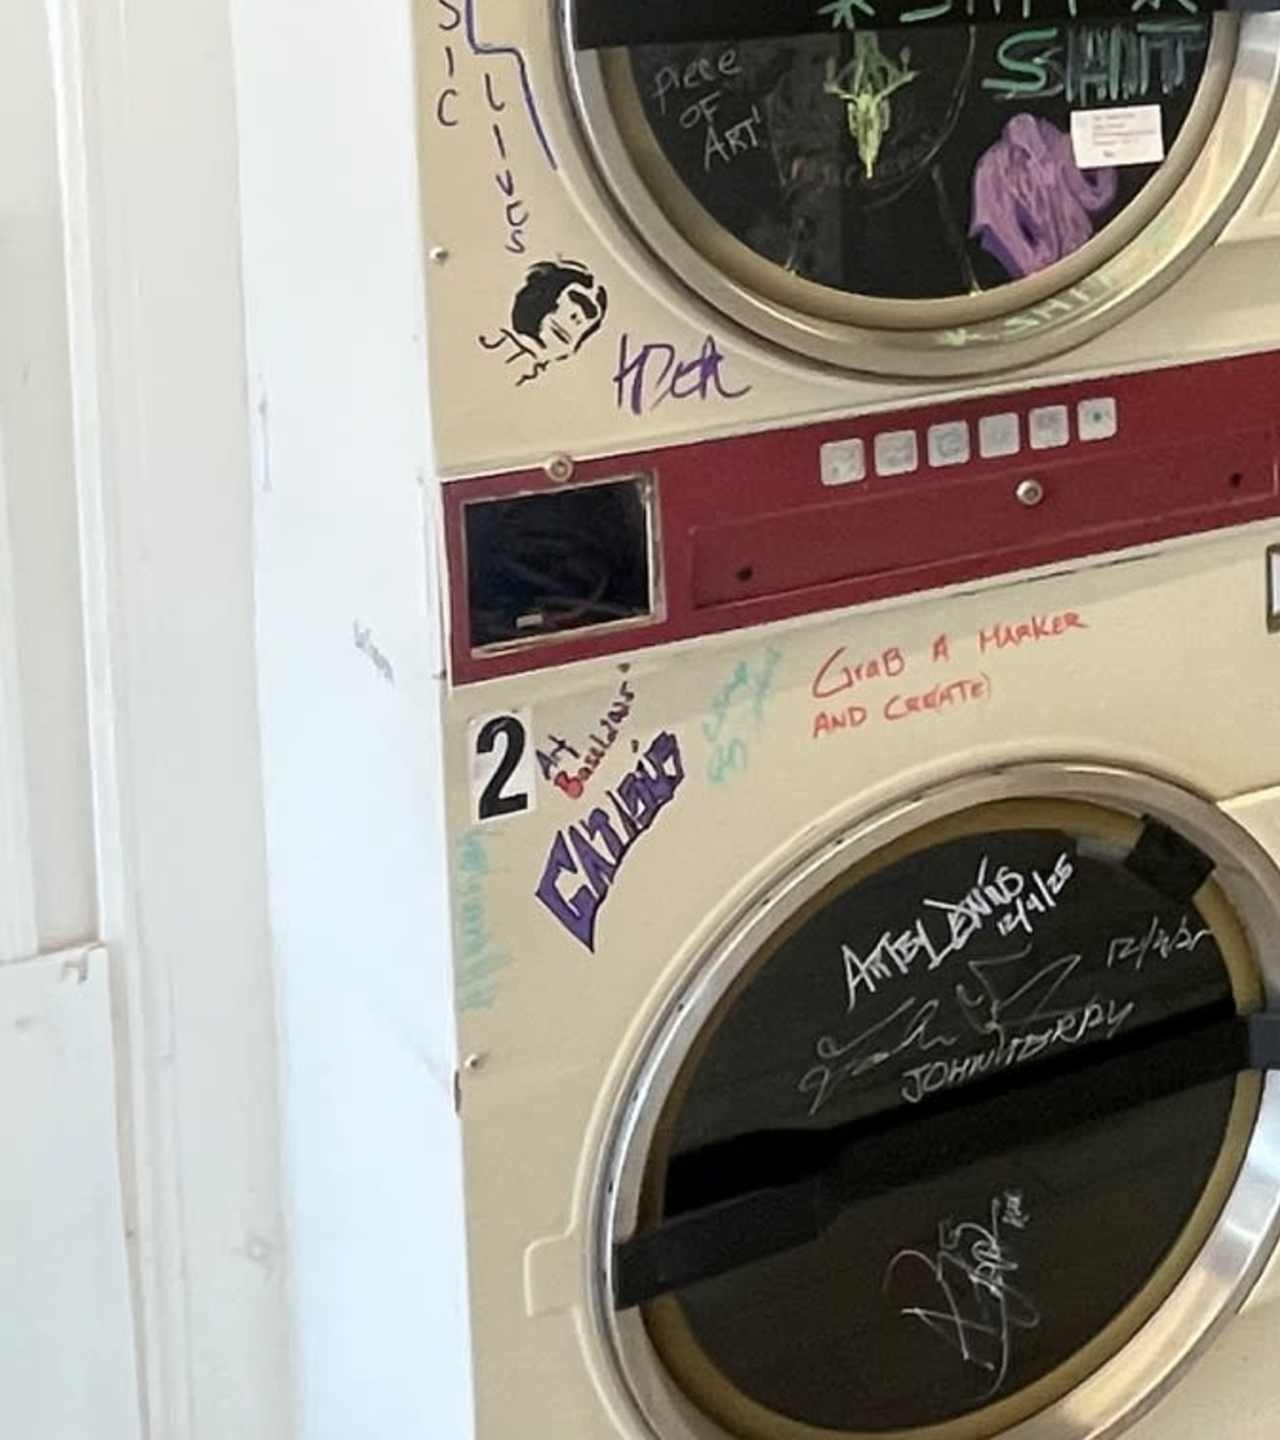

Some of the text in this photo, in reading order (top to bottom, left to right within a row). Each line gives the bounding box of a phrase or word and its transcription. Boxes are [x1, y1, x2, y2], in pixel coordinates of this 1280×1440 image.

[931, 632, 952, 664] A
[810, 702, 869, 739] AND
[475, 715, 529, 821] 2
